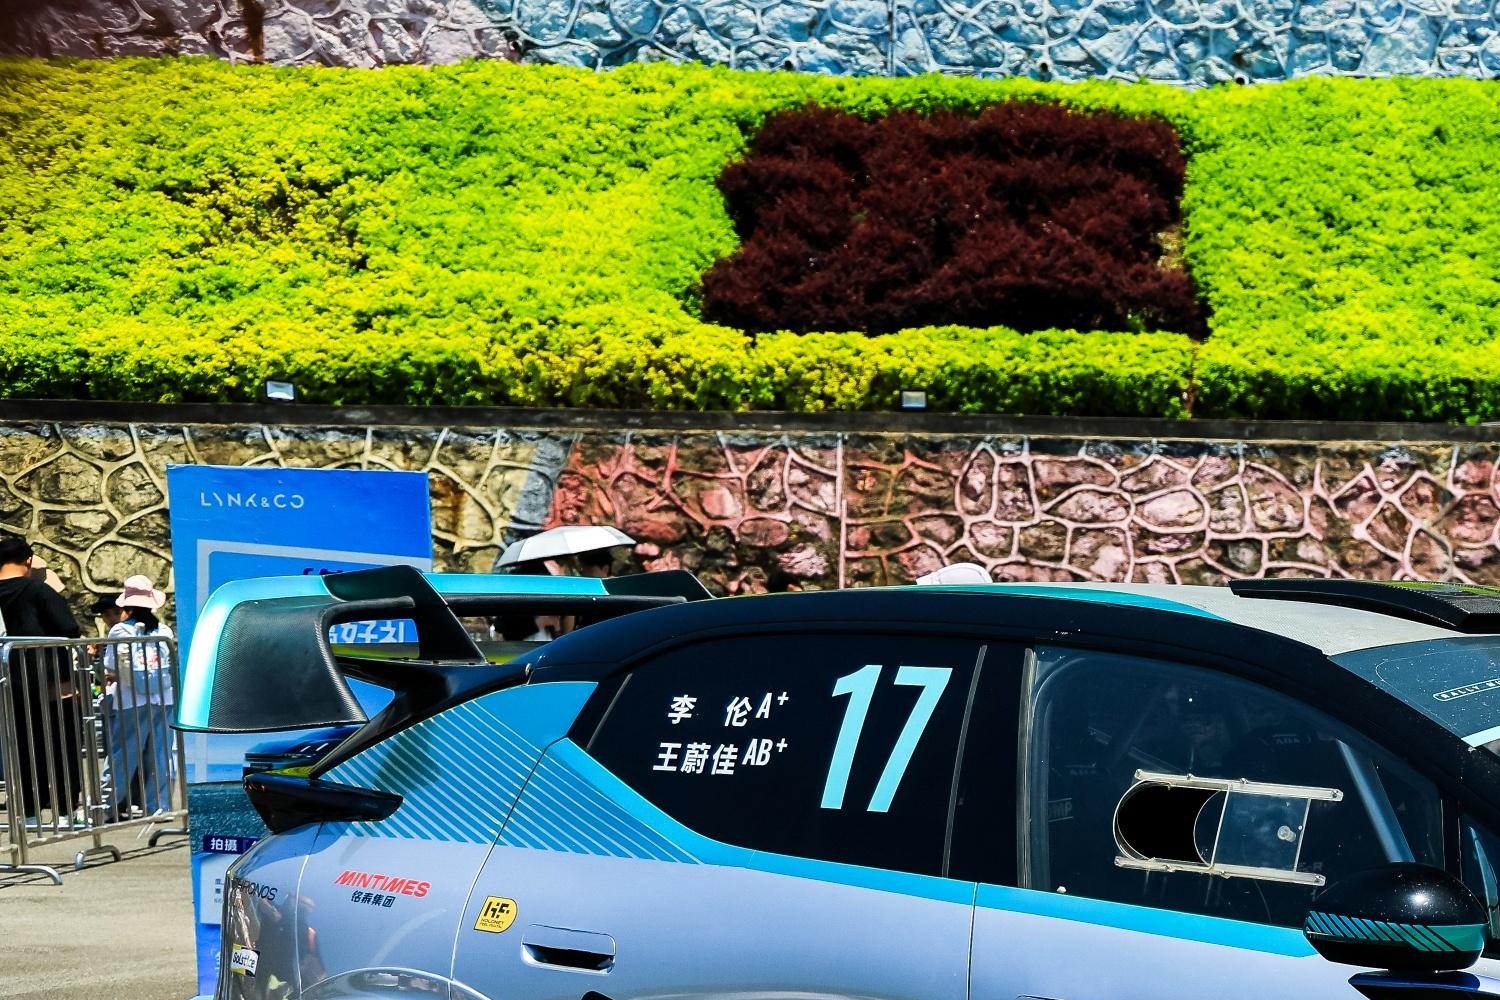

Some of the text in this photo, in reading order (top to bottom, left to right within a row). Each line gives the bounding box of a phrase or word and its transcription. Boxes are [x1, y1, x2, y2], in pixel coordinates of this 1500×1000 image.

[1438, 683, 1481, 700] RALLY
[820, 664, 953, 813] 17
[335, 870, 431, 898] MINTIMES
